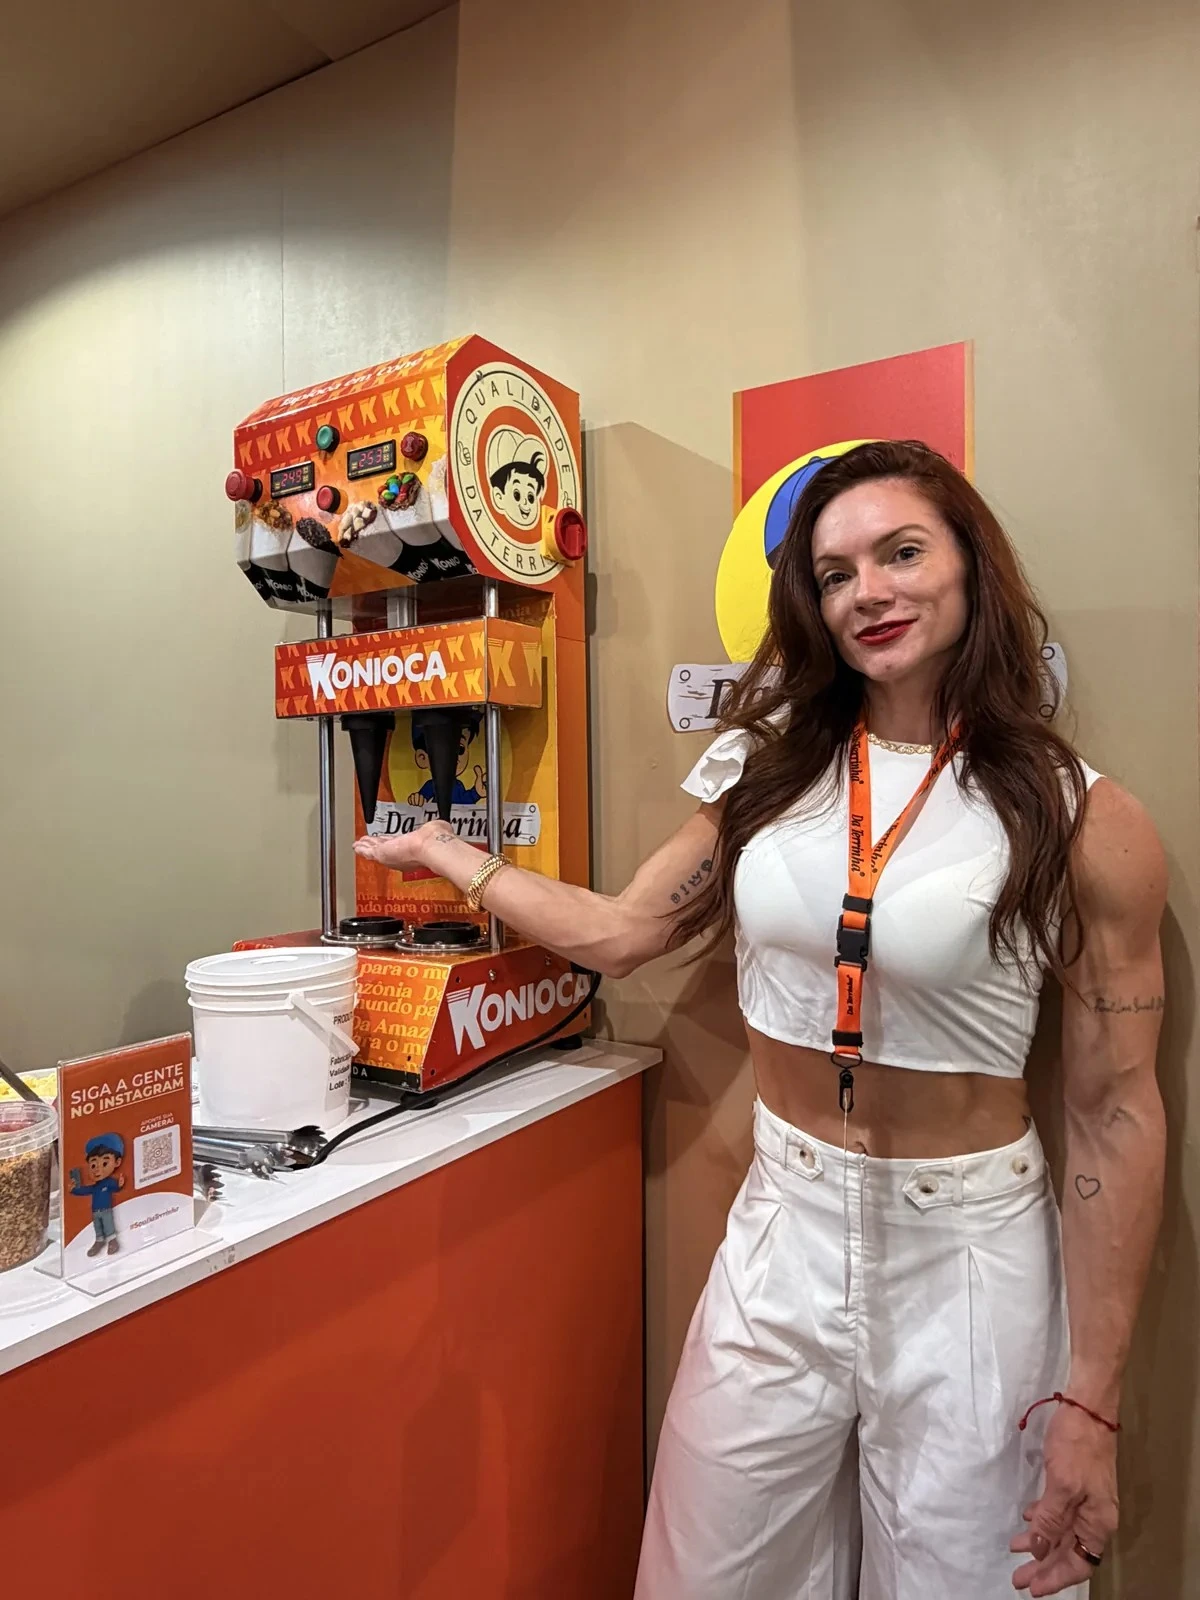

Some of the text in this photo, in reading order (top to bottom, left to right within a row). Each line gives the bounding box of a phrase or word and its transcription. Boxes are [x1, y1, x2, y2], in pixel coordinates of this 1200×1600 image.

[466, 380, 571, 473] QUALIDADE
[359, 449, 383, 468] 253
[281, 469, 302, 487] 249
[465, 486, 550, 570] DA TERRI
[306, 651, 447, 700] KONIOCA
[384, 811, 415, 835] Da
[851, 814, 863, 826] Da
[384, 903, 417, 915] para
[420, 904, 430, 913] o
[360, 962, 402, 977] para
[406, 966, 418, 978] o
[446, 972, 592, 1056] KONIOCA
[373, 1018, 431, 1039] Amaz
[386, 1040, 398, 1052] o
[71, 1083, 112, 1105] SIGA
[116, 1078, 128, 1093] A
[132, 1062, 184, 1087] GENTE
[71, 1077, 184, 1119] NO INSTAGRAM
